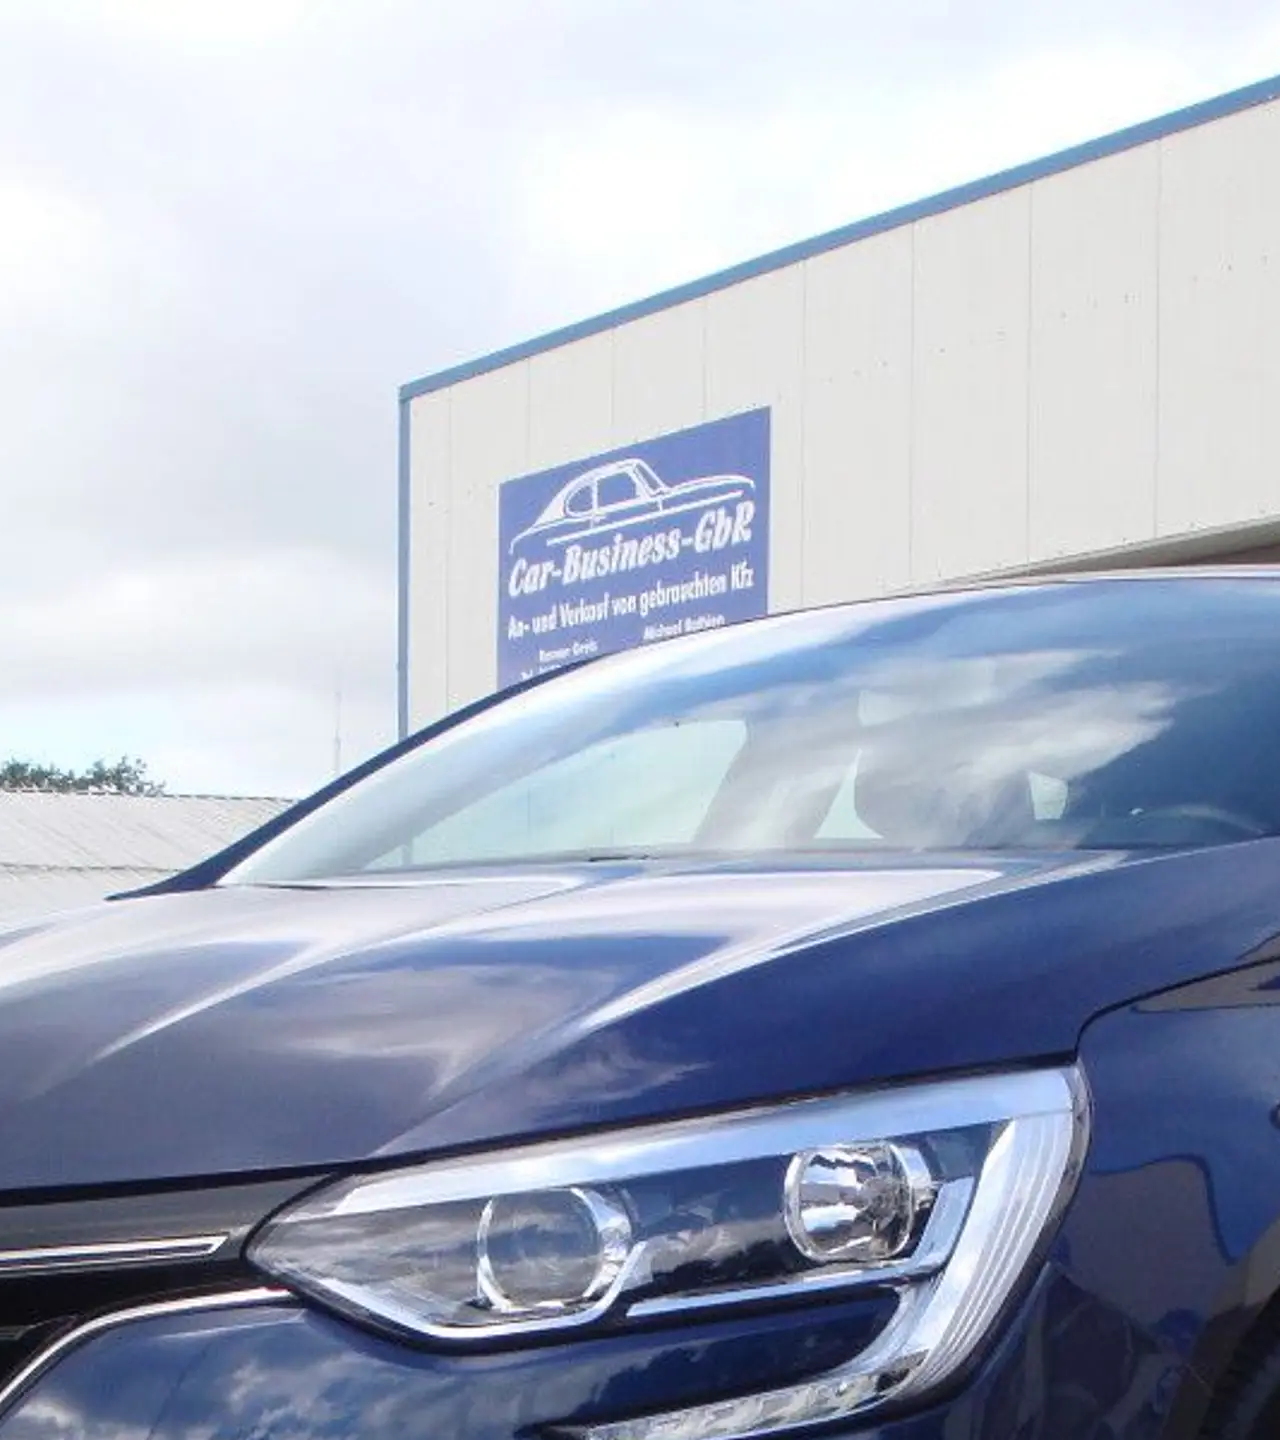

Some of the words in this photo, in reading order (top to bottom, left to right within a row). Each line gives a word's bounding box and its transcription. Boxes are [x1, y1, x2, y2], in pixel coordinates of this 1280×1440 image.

[508, 500, 756, 598] Car-Business-GbR
[532, 603, 557, 635] und
[559, 591, 610, 628] Verkauf
[611, 595, 637, 616] von
[639, 569, 728, 617] gebrauchten
[730, 560, 755, 591] Kfz
